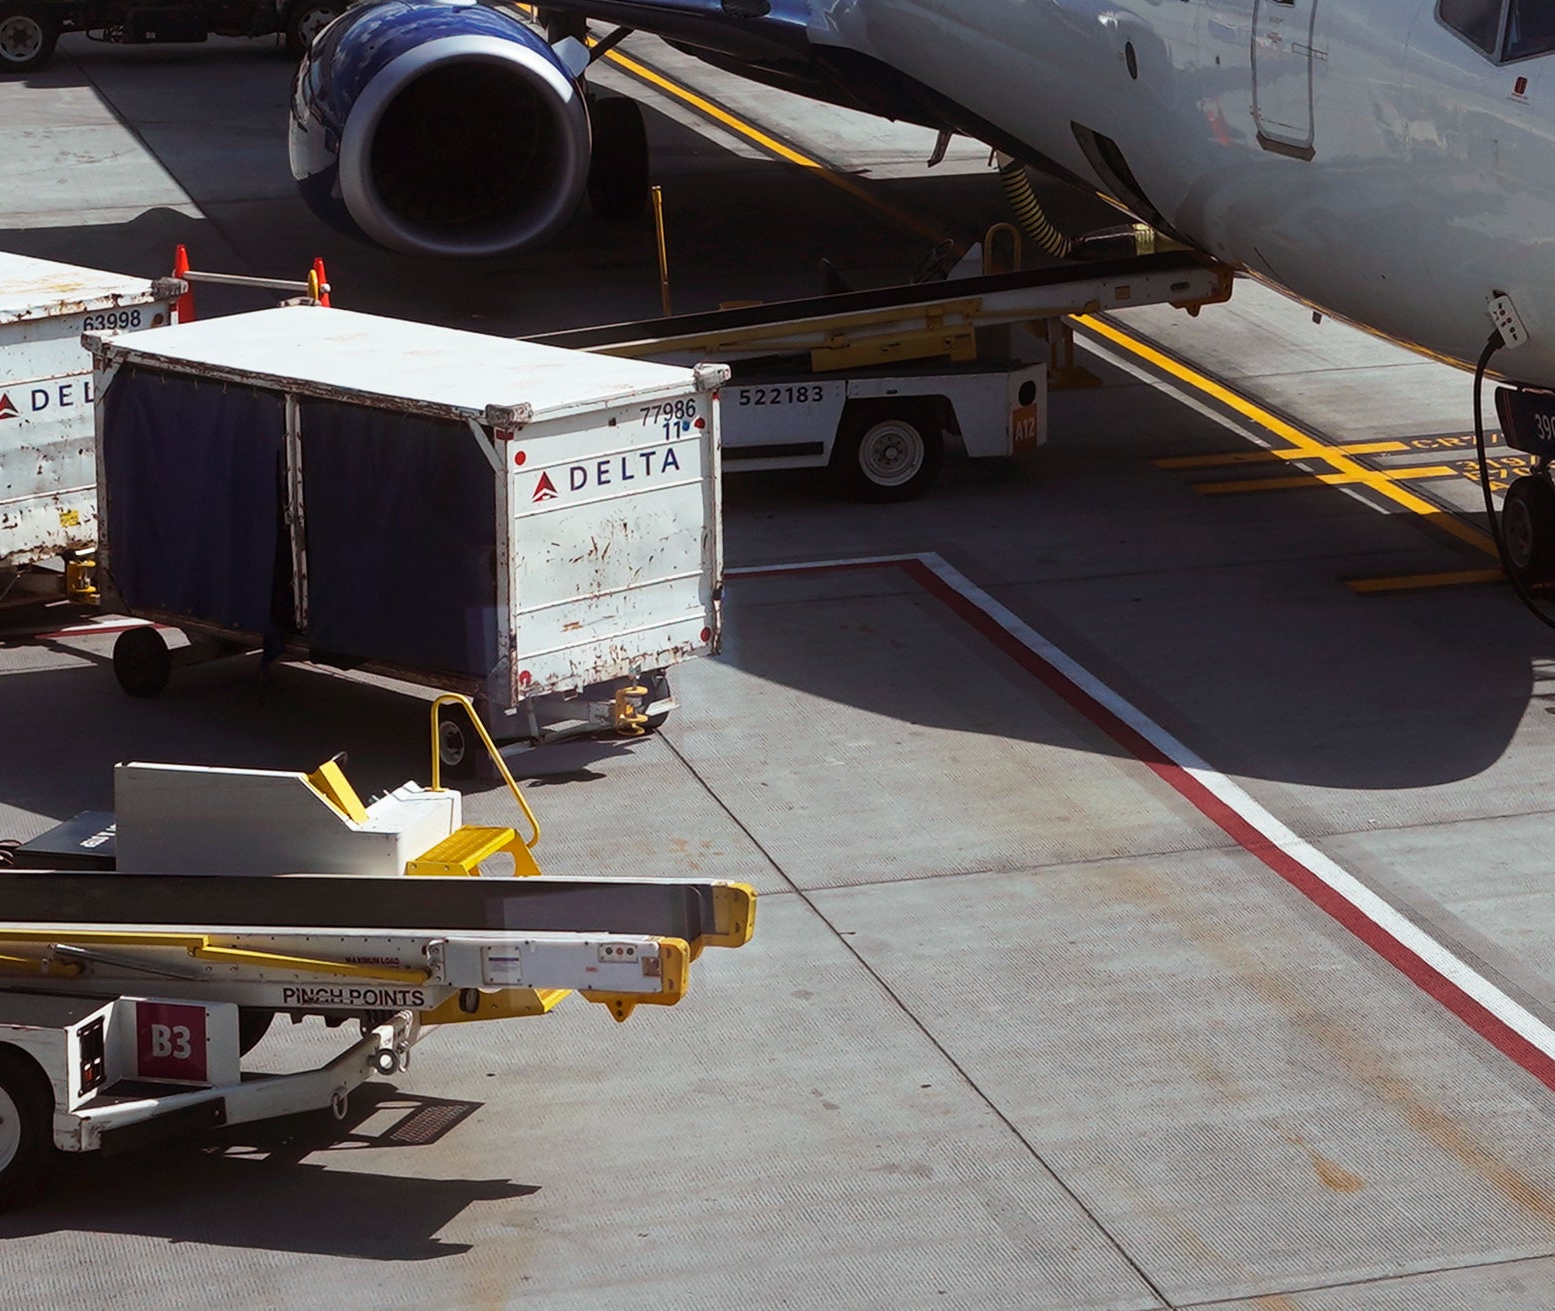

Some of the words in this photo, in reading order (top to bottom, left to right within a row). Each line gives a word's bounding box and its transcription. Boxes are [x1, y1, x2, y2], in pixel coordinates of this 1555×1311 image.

[83, 309, 141, 331] 63998
[31, 382, 95, 411] DEL
[739, 386, 823, 406] 522183
[639, 398, 696, 427] 77986
[663, 421, 681, 441] 11
[1015, 417, 1035, 441] A12
[570, 448, 680, 492] DELTA
[381, 957, 400, 965] LOAD
[283, 988, 342, 1006] PINCH
[350, 989, 424, 1006] POINTS
[152, 1023, 191, 1059] B3
